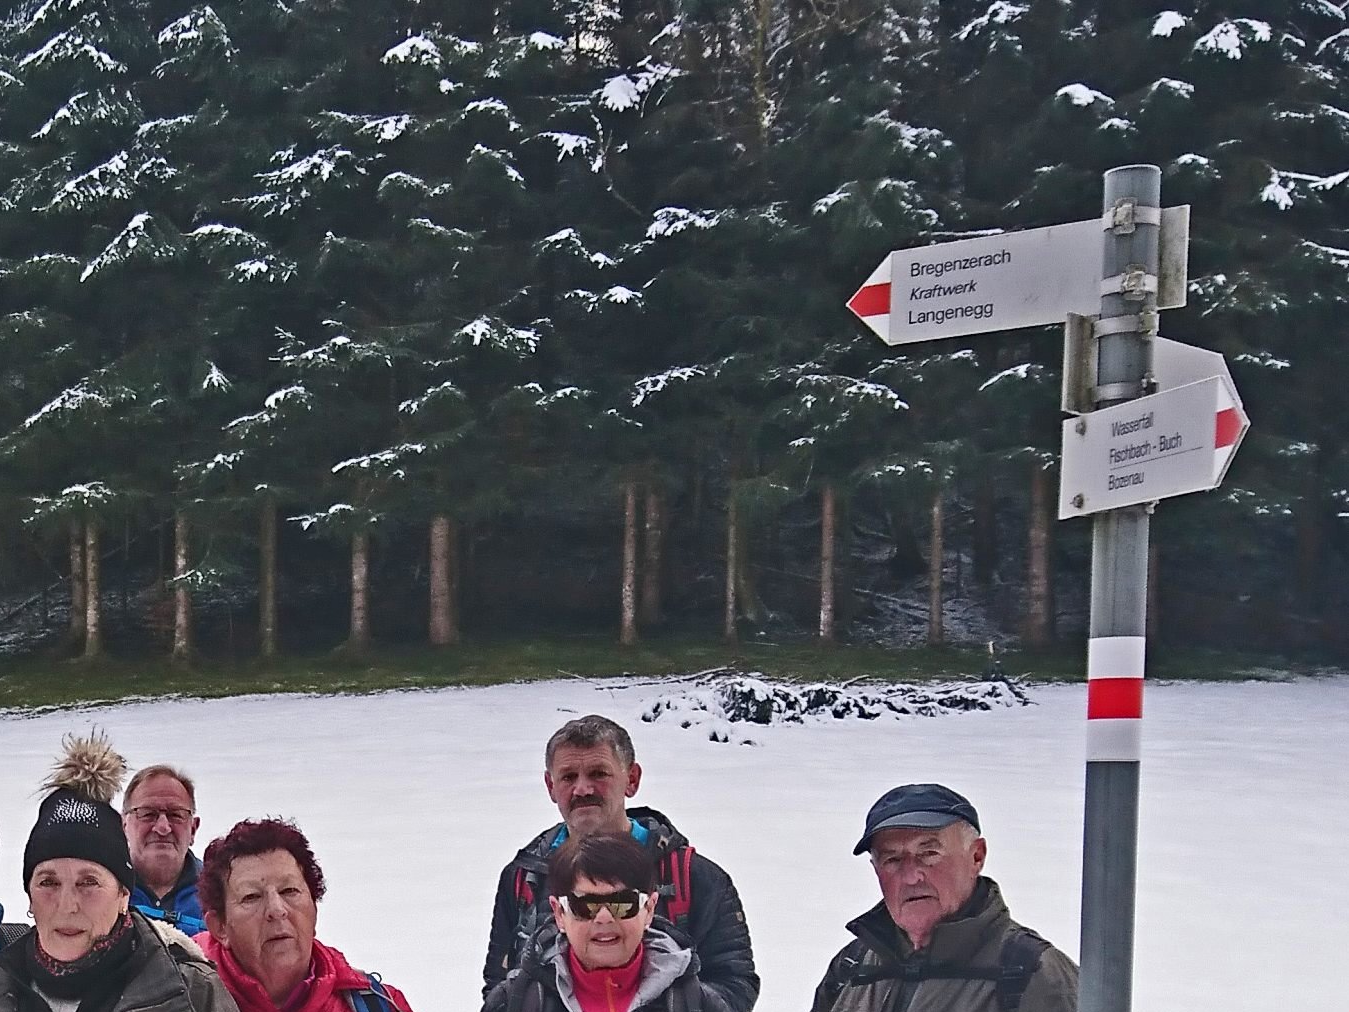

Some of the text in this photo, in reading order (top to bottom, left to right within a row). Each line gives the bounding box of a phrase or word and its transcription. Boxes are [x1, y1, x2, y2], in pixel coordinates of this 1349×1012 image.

[910, 249, 1012, 277] Bregenzerach
[909, 279, 978, 301] Kraftwerk
[908, 303, 994, 325] Langenegg
[1111, 411, 1154, 437] Wasserfall
[1109, 440, 1151, 464] Fischbach
[1159, 431, 1182, 452] Buch
[1108, 472, 1145, 491] Bozenau
